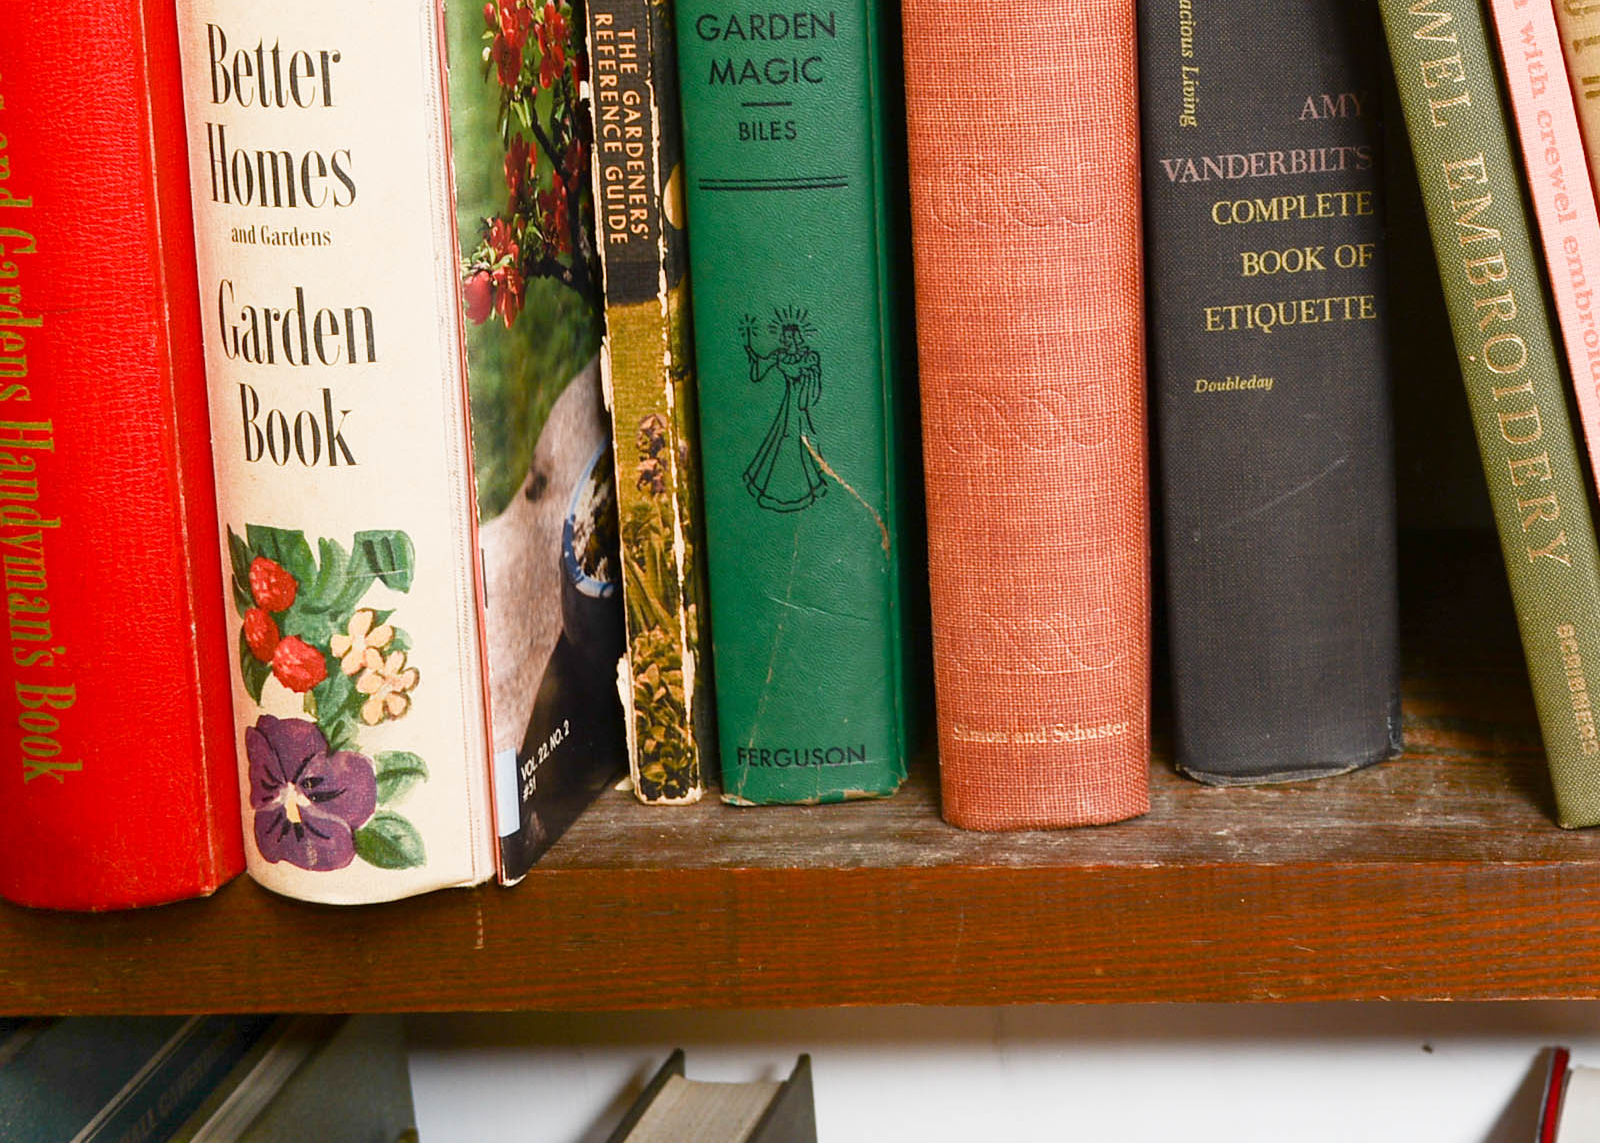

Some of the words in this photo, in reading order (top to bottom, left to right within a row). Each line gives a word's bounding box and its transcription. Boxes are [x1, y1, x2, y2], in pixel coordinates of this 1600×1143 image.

[696, 11, 836, 41] GARDEN
[205, 22, 341, 109] Better
[617, 27, 639, 77] THE
[708, 56, 825, 85] MAGIC
[594, 12, 622, 175] REFERENCE
[1179, 64, 1200, 128] Living
[1298, 91, 1369, 121] AMY
[738, 120, 798, 141] BILES
[1520, 19, 1547, 99] with
[1539, 109, 1580, 225] crewel
[205, 121, 357, 209] Homes
[623, 88, 649, 241] GARDENERS'
[1160, 145, 1373, 184] VANDERBILT'S
[605, 173, 628, 245] GUIDE
[1211, 190, 1374, 226] COMPLETE
[231, 226, 256, 245] and
[260, 225, 332, 247] Gardens
[1240, 246, 1327, 278] BOOK
[1334, 243, 1376, 269] OF
[218, 278, 379, 366] Garden
[1203, 294, 1377, 334] ETIQUETTE
[1193, 375, 1275, 394] Doubleday
[1442, 150, 1573, 569] EMBROIDERY
[237, 382, 361, 468] Book
[0, 419, 66, 668] Handyman's
[15, 680, 84, 785] Book
[736, 745, 867, 769] FERGUSON
[1015, 725, 1047, 744] and
[1053, 720, 1130, 743] Schuster
